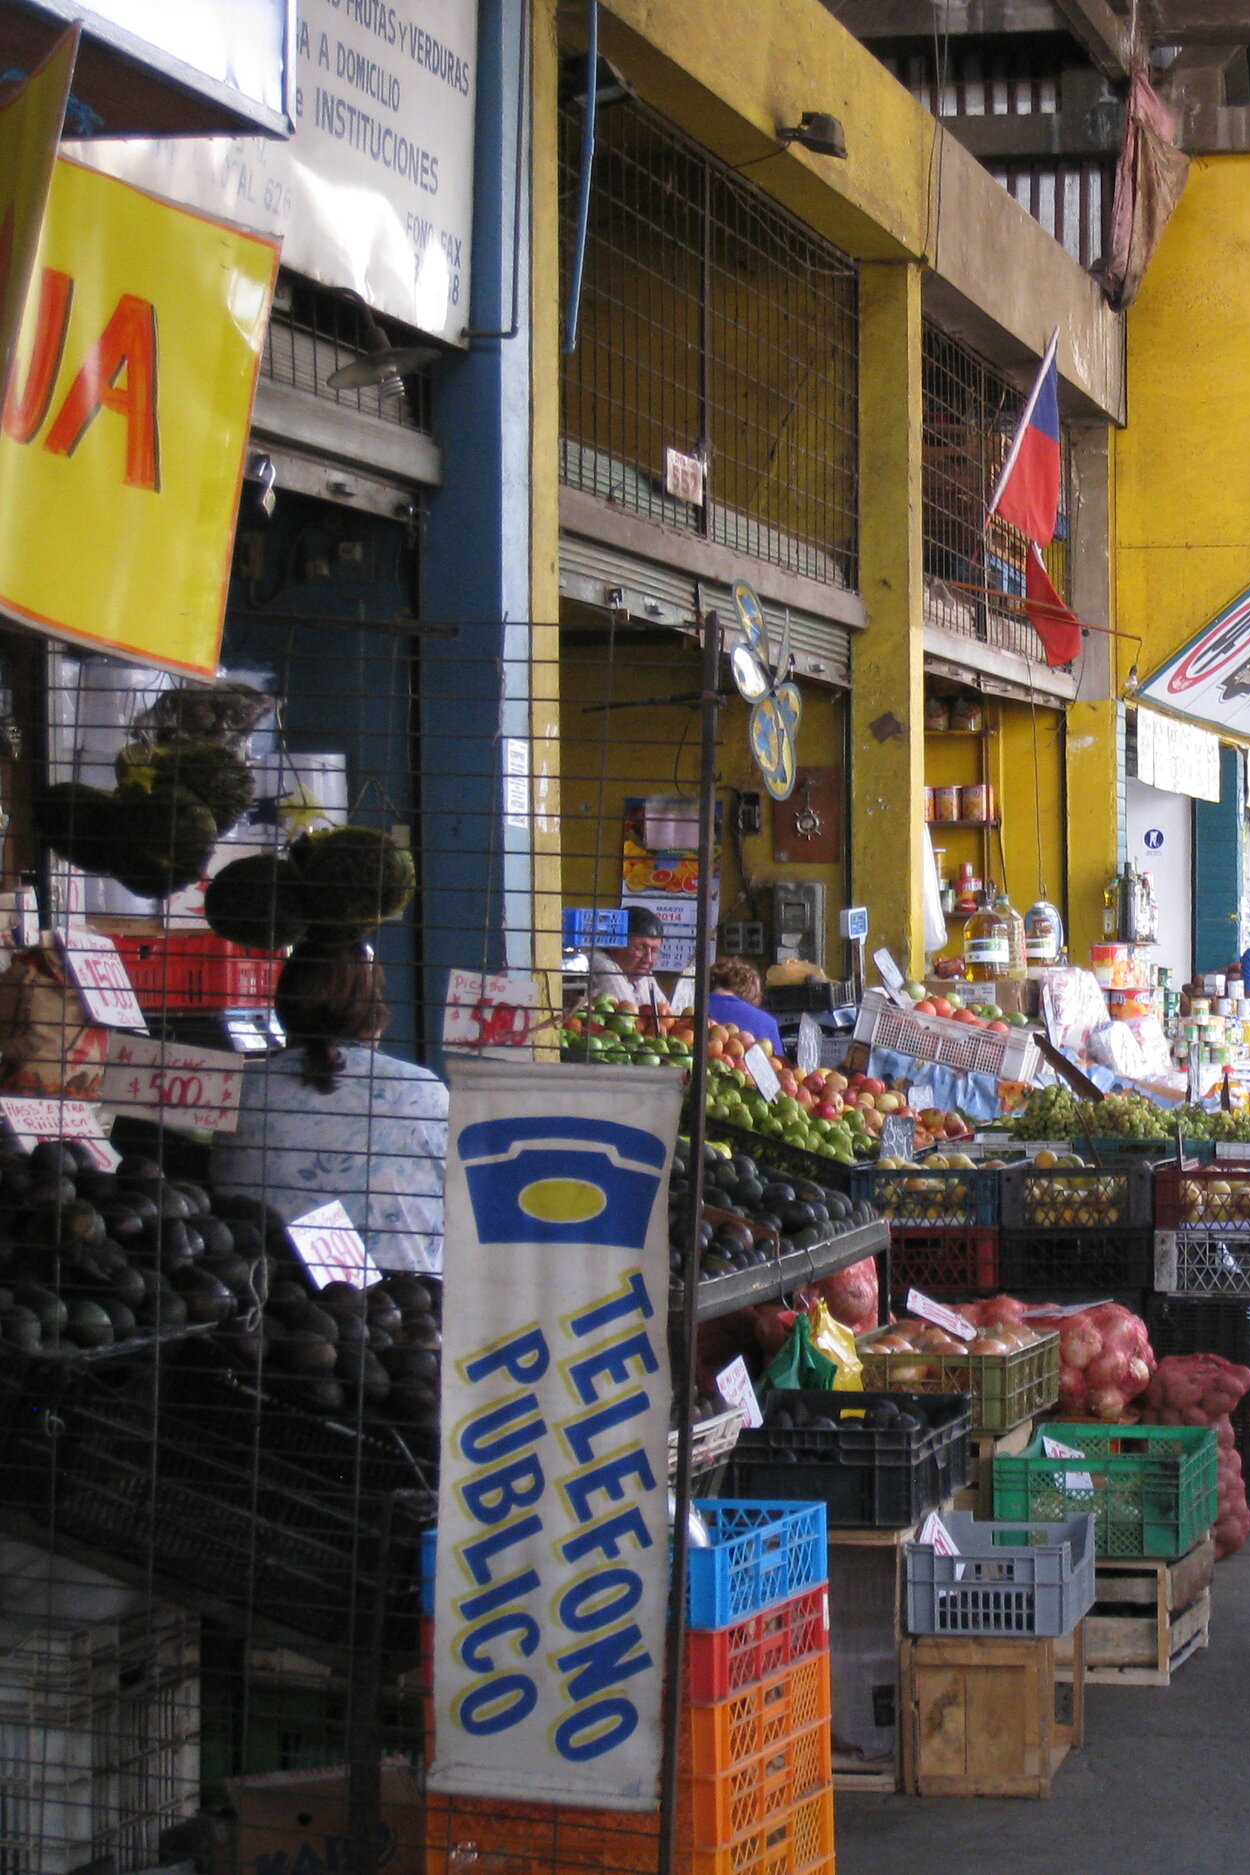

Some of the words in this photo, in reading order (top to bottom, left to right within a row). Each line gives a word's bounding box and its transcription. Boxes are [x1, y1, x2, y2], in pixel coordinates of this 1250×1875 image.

[319, 32, 330, 71] A
[336, 40, 400, 113] DOMICILIO
[398, 21, 408, 52] Y
[410, 22, 469, 96] VERDURAS
[315, 88, 439, 195] INSTITUCIONES
[656, 912, 682, 921] 2014
[450, 1322, 551, 1737] PUBLICO
[554, 1266, 660, 1762] TELEFONO
